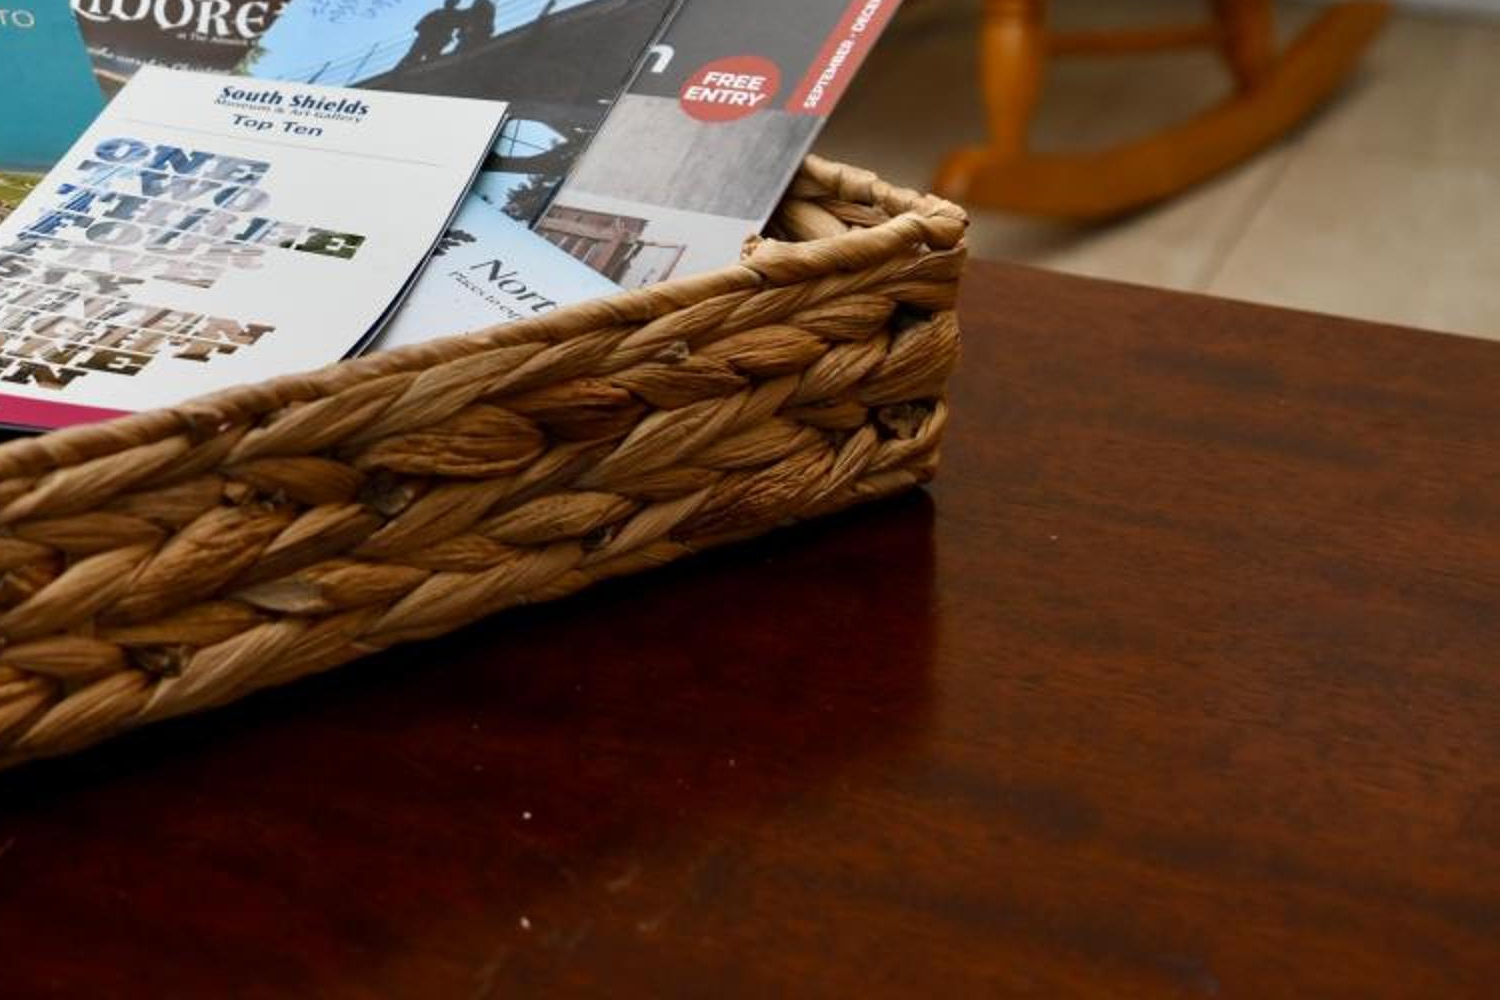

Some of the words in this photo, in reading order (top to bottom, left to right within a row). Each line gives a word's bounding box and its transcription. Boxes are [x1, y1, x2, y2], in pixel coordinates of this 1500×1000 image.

[683, 86, 767, 107] ENTRY
[702, 71, 767, 91] FREE
[803, 39, 855, 108] SEPTEMBER
[214, 98, 271, 112] Museum
[314, 112, 364, 123] Gallery
[223, 85, 283, 105] South
[290, 94, 370, 116] Shields
[232, 114, 273, 131] Top
[283, 121, 324, 137] Ten
[76, 159, 271, 213] TWO
[94, 136, 271, 186] ONE
[17, 211, 265, 270] FOUR
[55, 182, 367, 261] THREE
[470, 259, 557, 312] Nort
